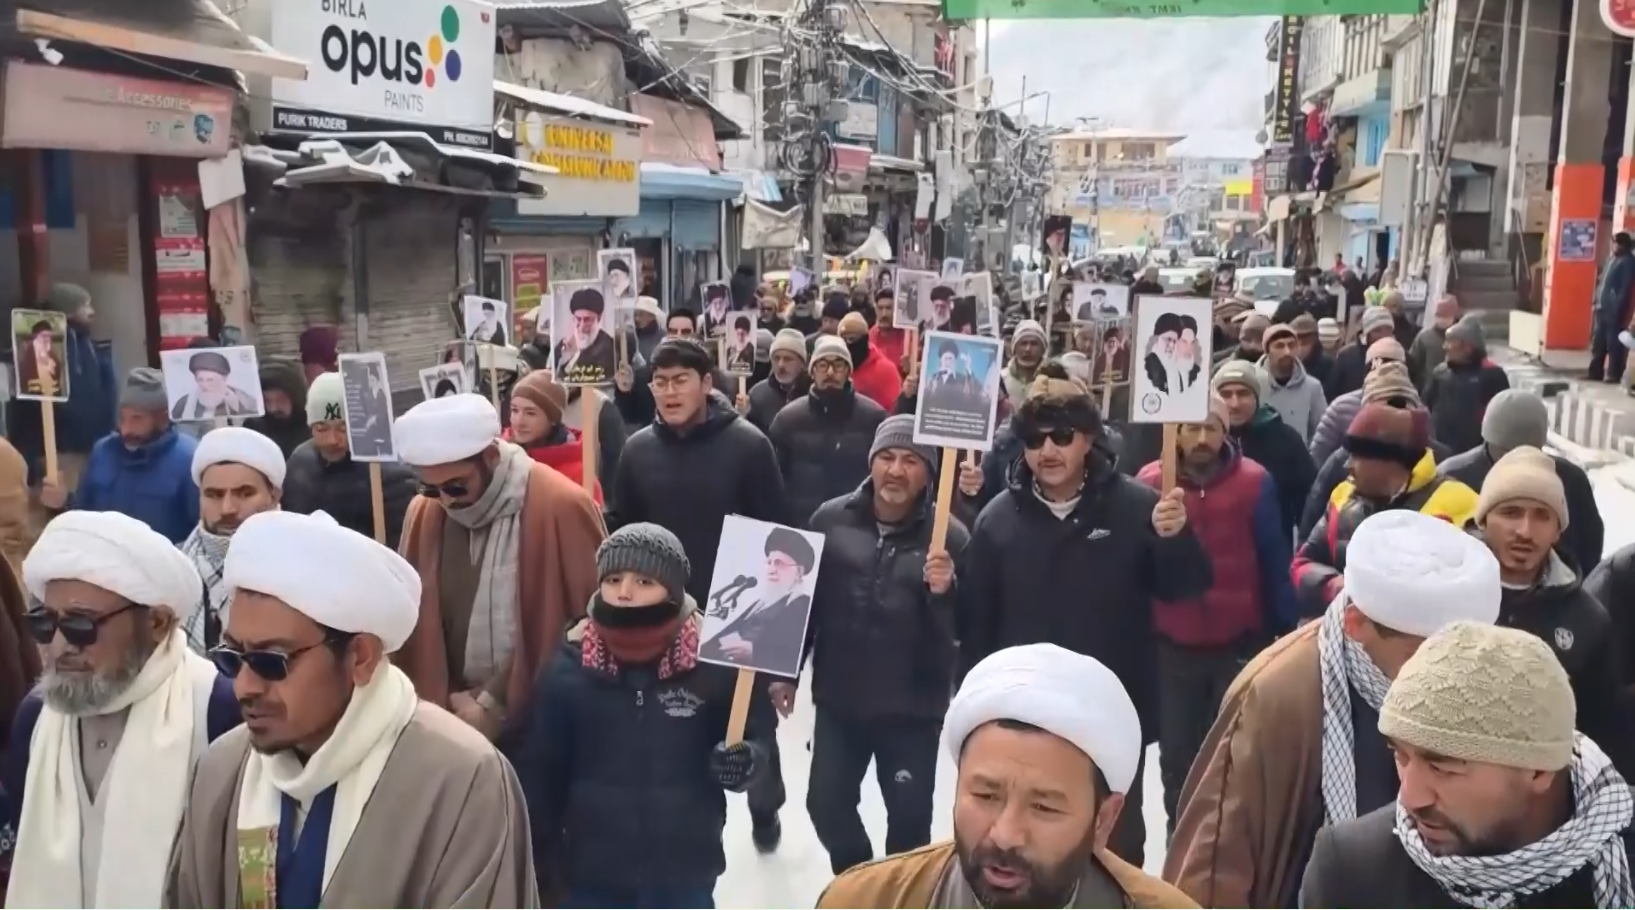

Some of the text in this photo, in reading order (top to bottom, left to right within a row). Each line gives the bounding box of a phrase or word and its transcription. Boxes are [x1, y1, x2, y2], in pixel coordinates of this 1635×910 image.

[321, 24, 423, 85] opus
[384, 90, 424, 112] PAINTS
[278, 112, 348, 131] PURIK TRADERS
[324, 402, 342, 420] NY
